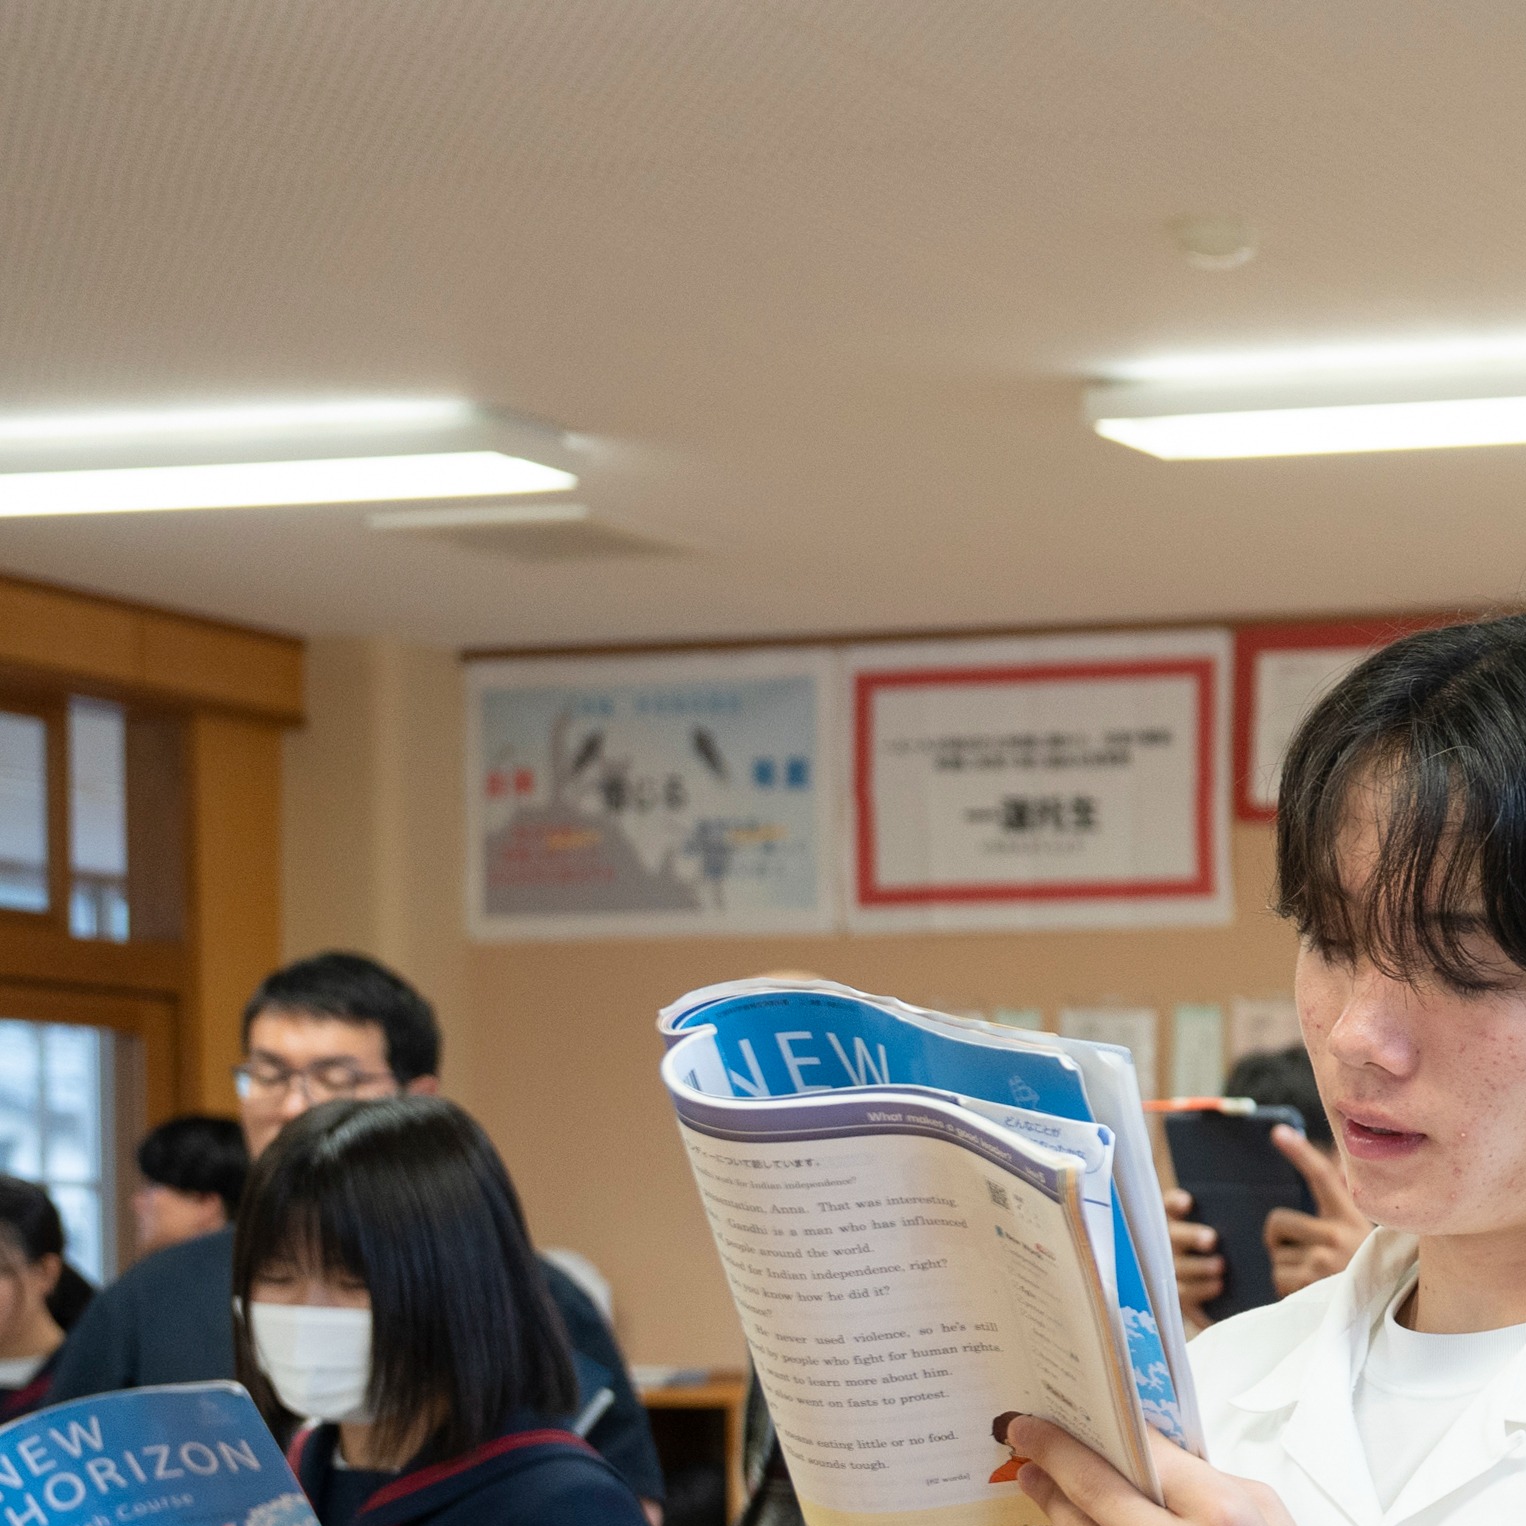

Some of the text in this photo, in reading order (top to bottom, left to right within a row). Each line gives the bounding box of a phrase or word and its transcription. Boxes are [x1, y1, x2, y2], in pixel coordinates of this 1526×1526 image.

[866, 1111, 903, 1123] What
[906, 1113, 945, 1128] makes
[785, 1176, 857, 1191] independence?
[771, 1204, 809, 1215] Anna.
[817, 1202, 850, 1213] That
[855, 1200, 882, 1209] was
[886, 1195, 959, 1209] interesting.
[727, 1215, 969, 1237] Gandhi is a man who has influenced
[760, 1248, 802, 1259] around
[807, 1247, 829, 1258] the
[833, 1243, 875, 1255] world.
[766, 1267, 808, 1281] Indian
[811, 1266, 907, 1281] independence,
[910, 1258, 949, 1272] right?
[743, 1283, 760, 1297] you
[762, 1286, 793, 1301] know
[797, 1293, 823, 1302] how
[828, 1291, 844, 1302] he
[848, 1288, 870, 1300] did
[873, 1285, 892, 1298] it?
[775, 1332, 808, 1345] never
[815, 1334, 845, 1345] used
[854, 1331, 911, 1345] violence,
[919, 1326, 934, 1336] so
[941, 1322, 967, 1334] he's
[974, 1321, 999, 1333] still
[783, 1352, 820, 1367] people
[824, 1355, 850, 1366] who
[853, 1353, 885, 1367] fight
[888, 1350, 908, 1362] for
[911, 1345, 958, 1359] human
[962, 1342, 1004, 1355] rights.
[767, 1367, 790, 1383] want
[793, 1375, 805, 1385] to
[808, 1375, 841, 1387] learn
[845, 1377, 878, 1388] more
[882, 1371, 919, 1384] about
[922, 1366, 953, 1379] him.
[796, 1396, 824, 1408] went
[828, 1399, 844, 1409] on
[848, 1396, 879, 1408] fasts
[883, 1396, 896, 1406] to
[900, 1389, 950, 1406] protest.
[817, 1438, 853, 1452] eating
[856, 1438, 887, 1450] little
[891, 1439, 905, 1449] or
[909, 1437, 925, 1447] no
[928, 1431, 960, 1443] food.
[808, 1456, 847, 1469] sounds
[850, 1460, 890, 1472] tough.
[116, 1492, 195, 1523] Course
